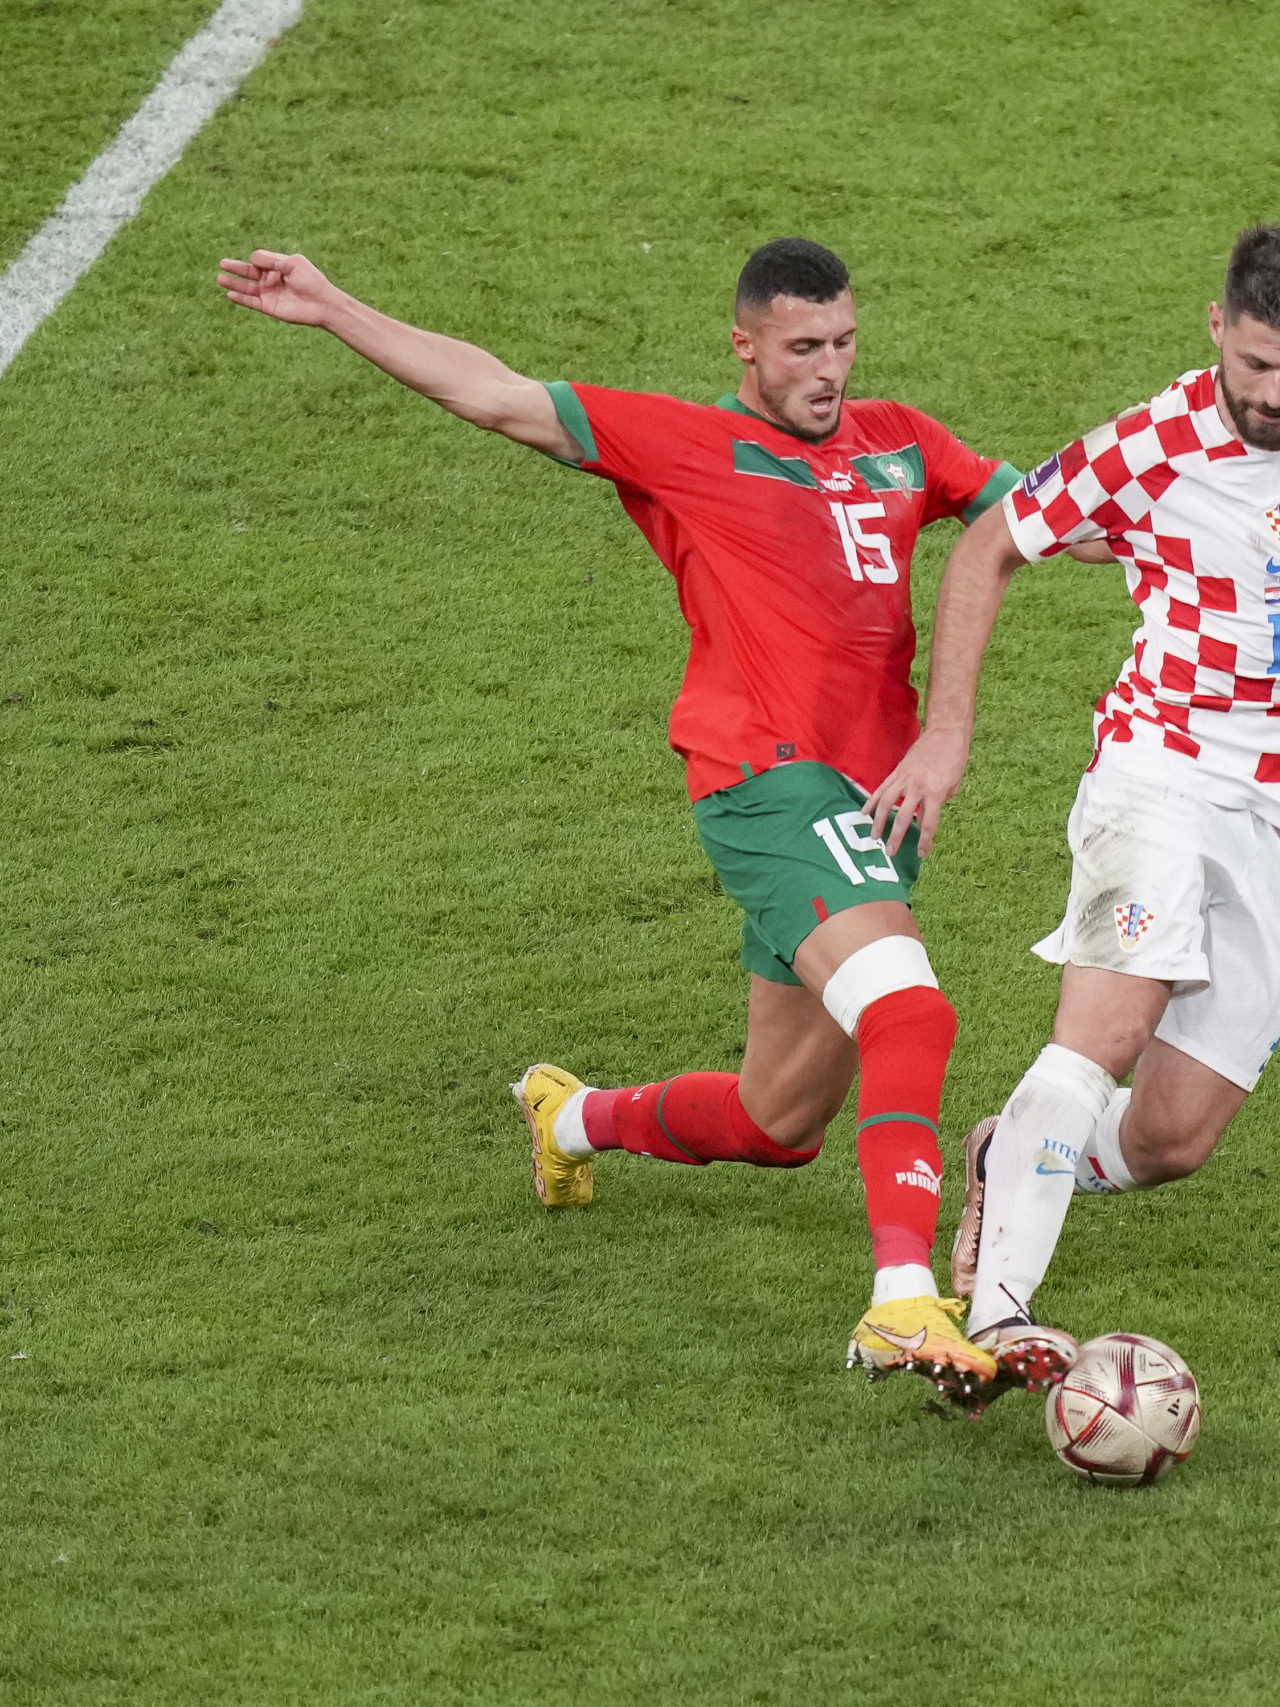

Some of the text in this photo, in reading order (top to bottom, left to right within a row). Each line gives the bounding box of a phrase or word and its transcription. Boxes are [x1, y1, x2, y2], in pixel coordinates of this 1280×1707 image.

[829, 501, 899, 584] 15
[813, 811, 899, 885] 15
[895, 1171, 941, 1197] PUMA
